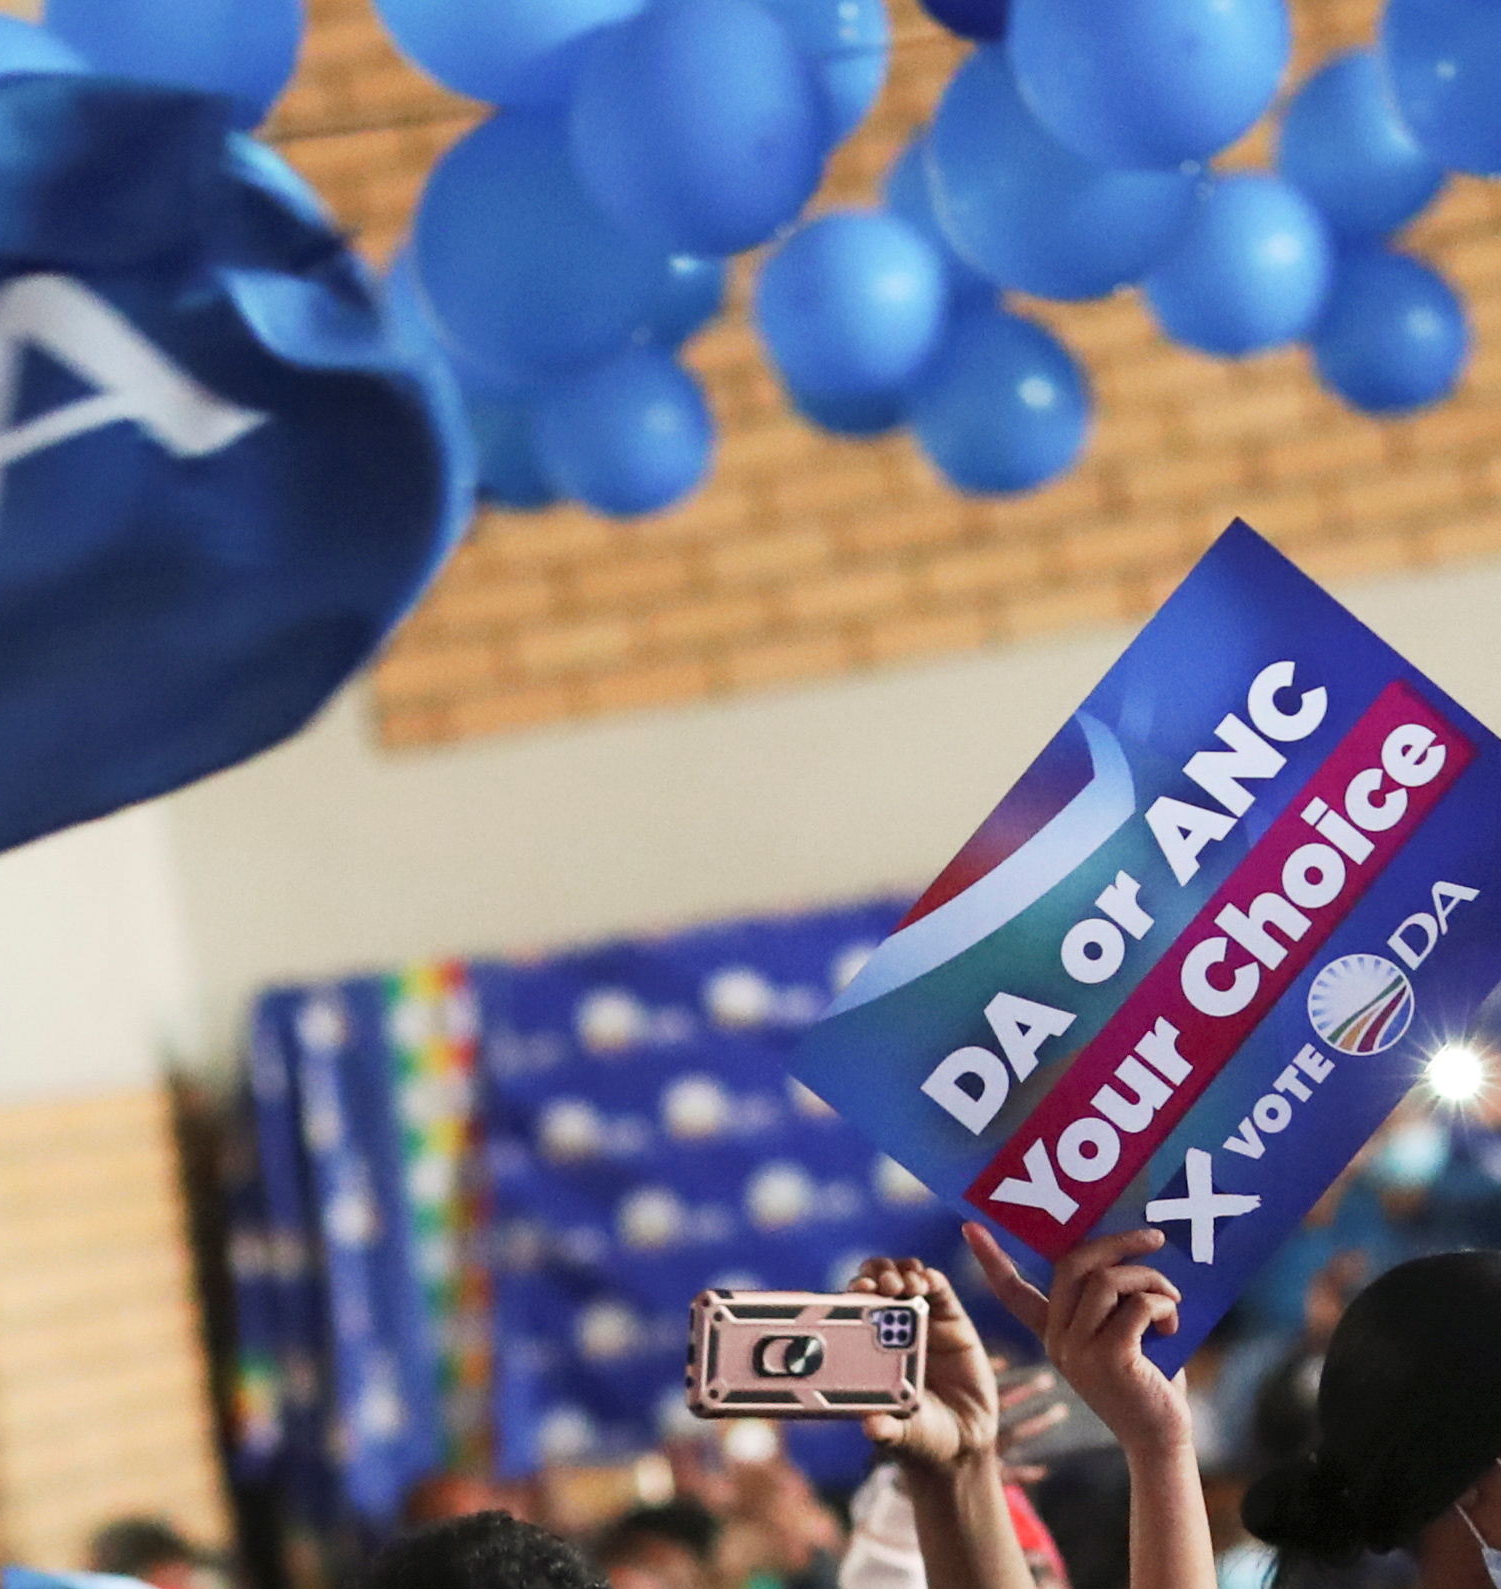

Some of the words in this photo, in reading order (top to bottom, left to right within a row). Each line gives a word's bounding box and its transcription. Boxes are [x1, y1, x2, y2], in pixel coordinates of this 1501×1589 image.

[921, 992, 1076, 1135] DA
[1061, 870, 1155, 983] or
[1144, 661, 1328, 886] ANC
[990, 1016, 1194, 1225] Your
[1181, 723, 1446, 1017] Choice
[1223, 1042, 1336, 1159] VOTE
[1387, 880, 1480, 970] DA
